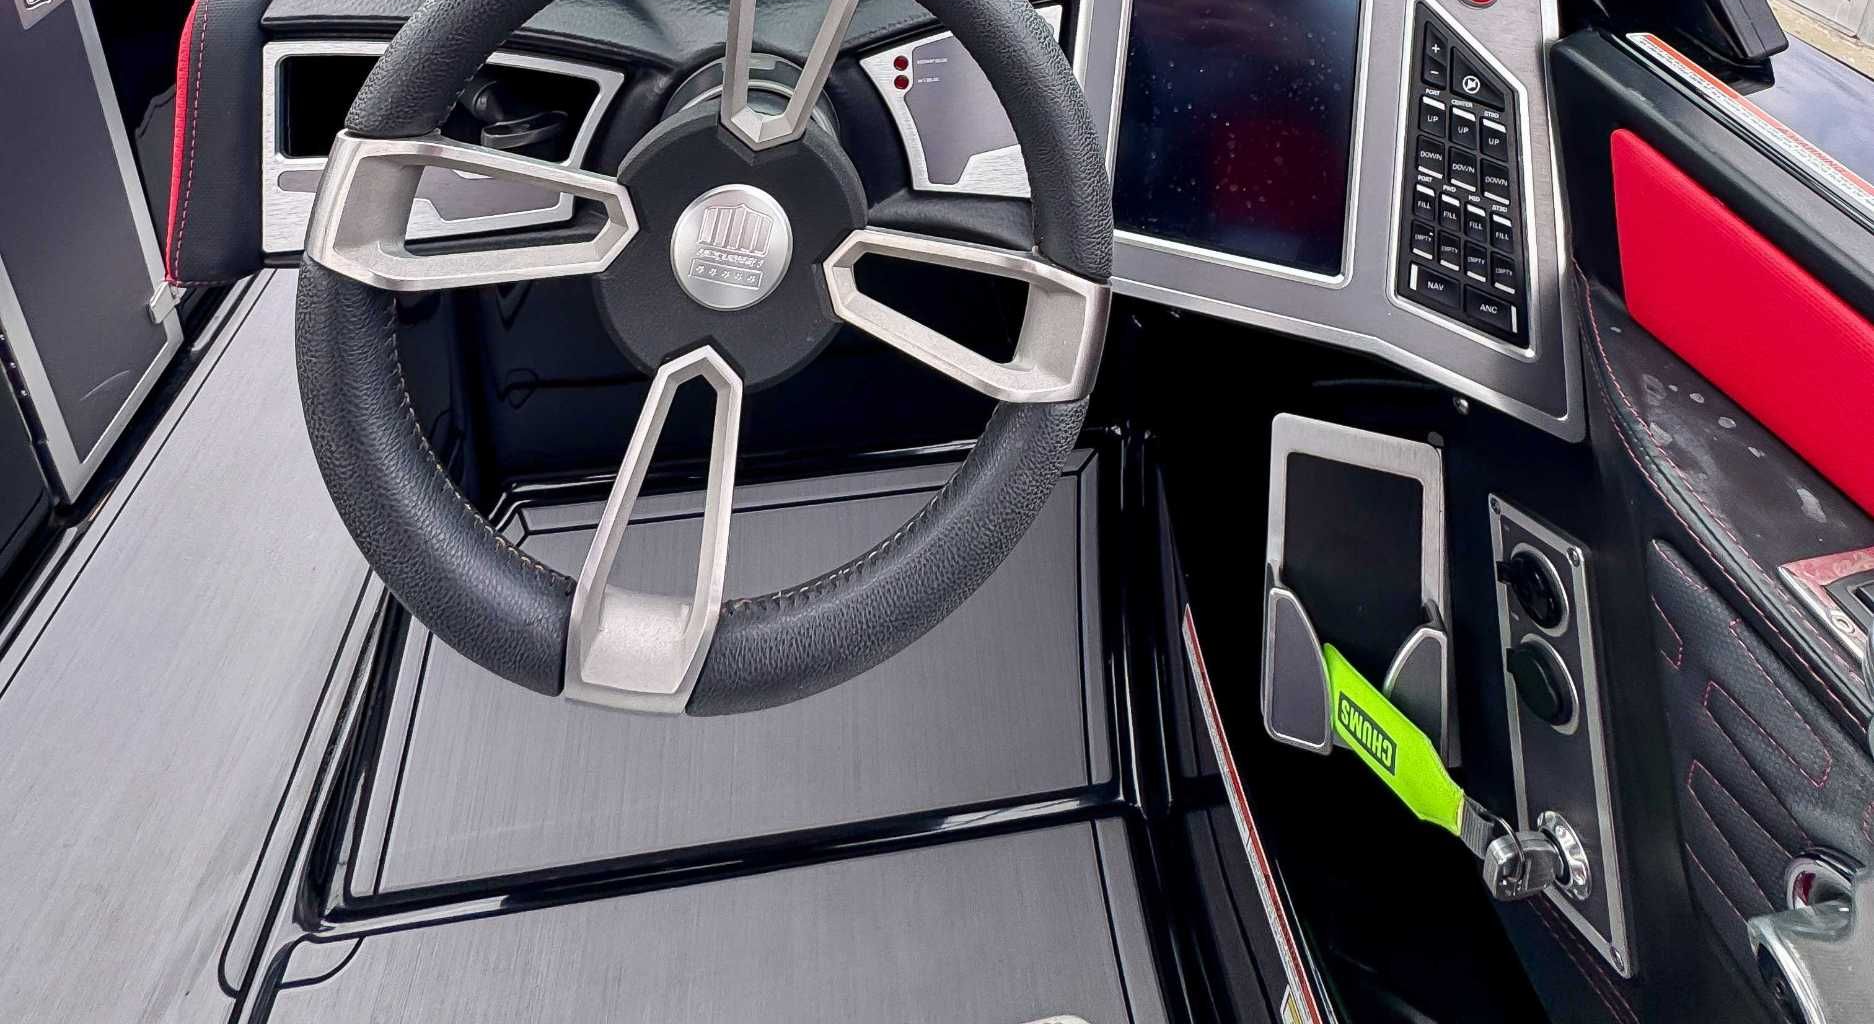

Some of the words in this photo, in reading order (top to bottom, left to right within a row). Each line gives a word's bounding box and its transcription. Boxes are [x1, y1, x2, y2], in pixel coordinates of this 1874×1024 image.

[1425, 88, 1441, 96] PORT
[1457, 126, 1469, 134] UP
[1420, 150, 1442, 161] DOWN
[1452, 163, 1475, 174] DOWN
[1485, 176, 1508, 186] DOWN
[1417, 200, 1431, 209] FILL
[1443, 211, 1457, 220] FILL
[1469, 222, 1483, 230] FILL
[1415, 234, 1432, 242] EMPTY
[1495, 232, 1509, 241] FILL
[1441, 245, 1458, 254] EMPTY
[1467, 257, 1485, 265] EMPTY
[1427, 281, 1444, 291] NAV
[1480, 303, 1498, 314] ANC
[1341, 699, 1393, 768] CHUMS
